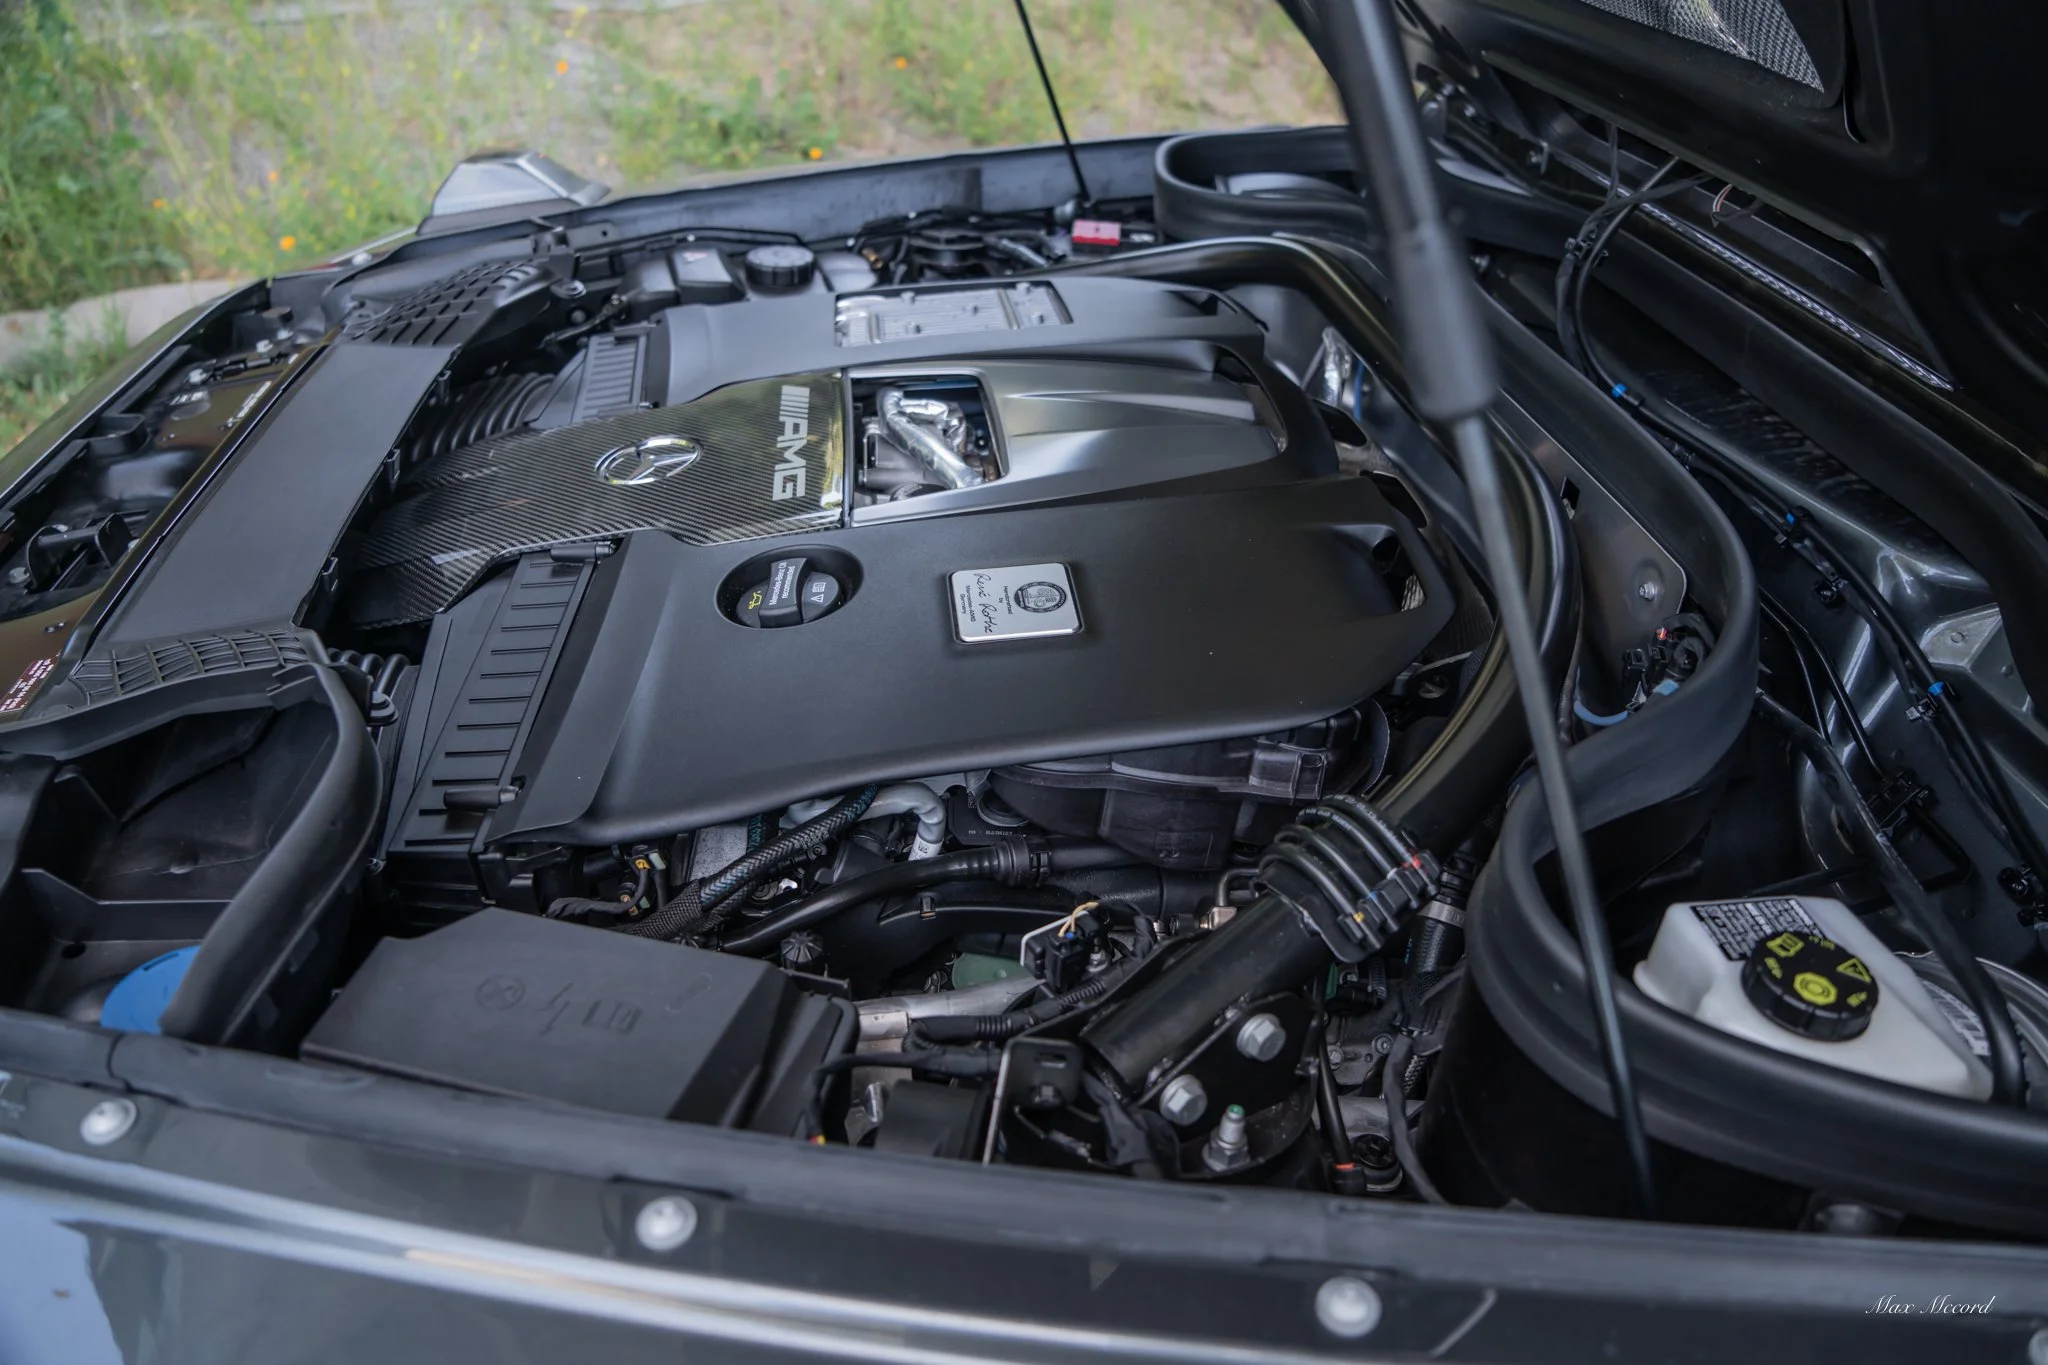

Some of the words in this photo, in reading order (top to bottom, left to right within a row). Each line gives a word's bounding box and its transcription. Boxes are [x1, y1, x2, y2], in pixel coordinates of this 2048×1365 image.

[772, 414, 808, 501] AMG
[769, 568, 786, 605] Mercedes-Benz
[782, 565, 796, 599] recommended
[1003, 586, 1013, 615] Handcrafted
[965, 585, 976, 622] Mercedes-AMG
